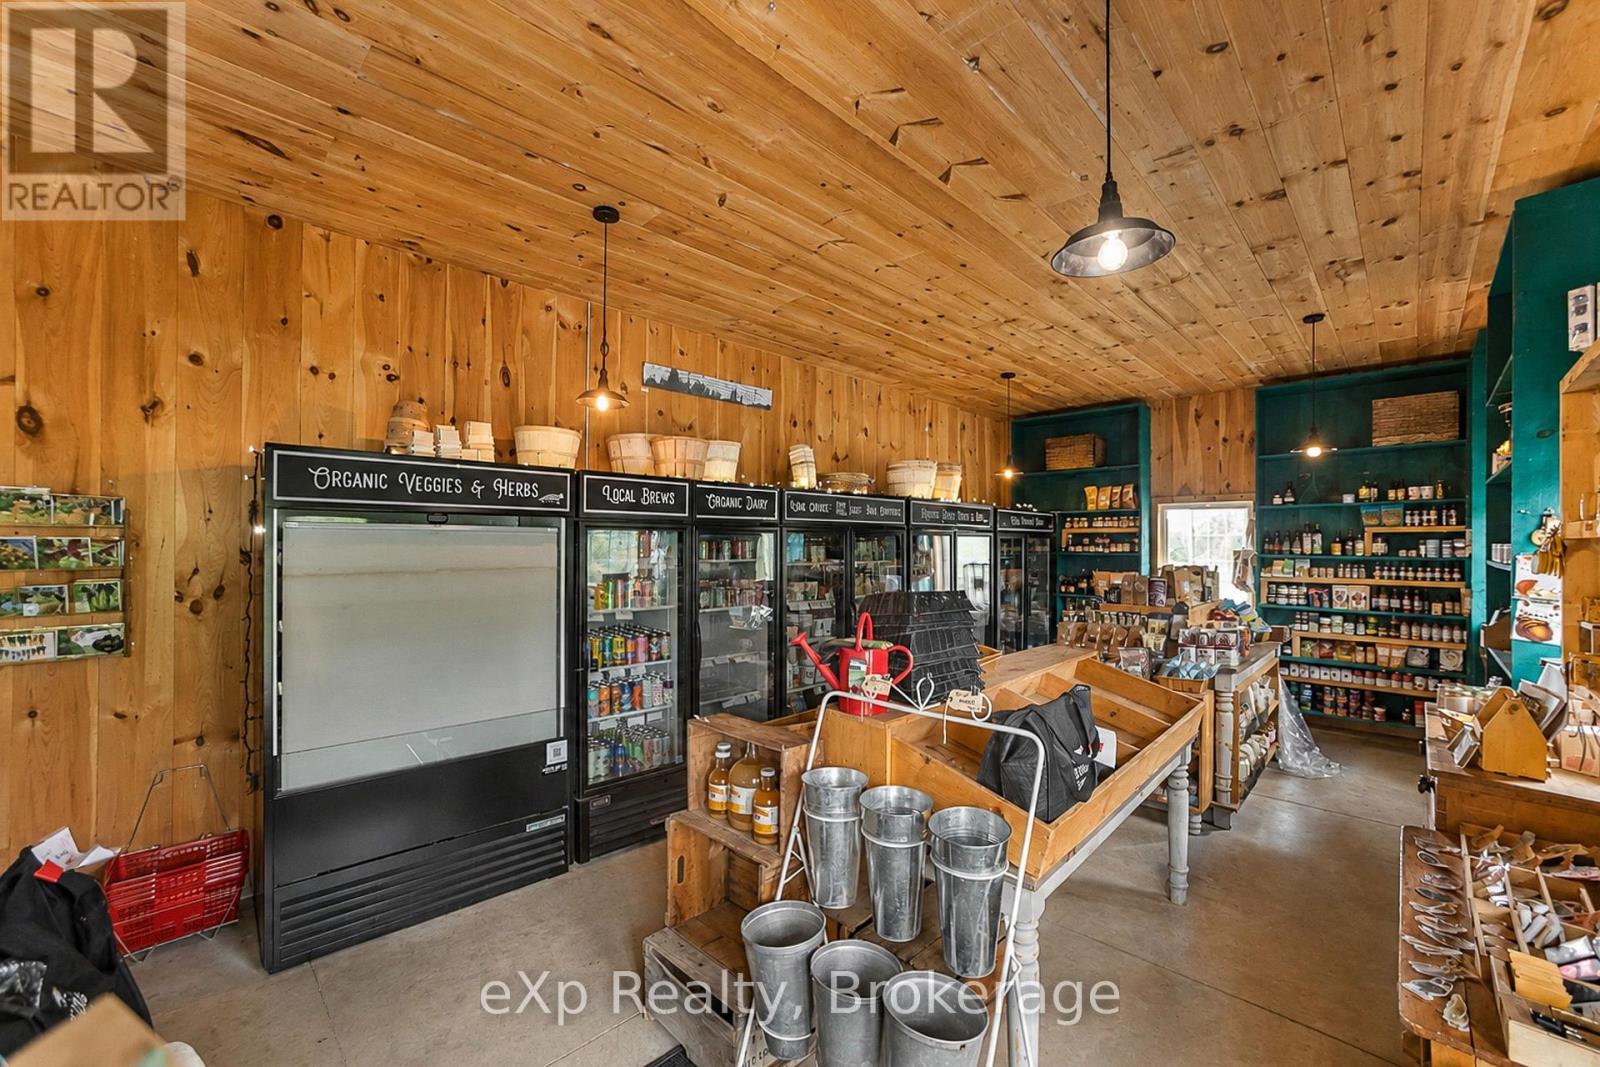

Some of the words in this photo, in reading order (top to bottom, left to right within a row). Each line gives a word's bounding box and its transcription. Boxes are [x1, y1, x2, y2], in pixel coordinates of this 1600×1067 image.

[308, 466, 389, 490] ORGANIC
[398, 471, 463, 495] VEGGIES
[471, 479, 486, 499] &
[493, 477, 539, 500] HERBS
[602, 484, 636, 505] LOCAL
[640, 486, 676, 506] BREWS
[705, 493, 743, 510] ORGANIC
[745, 495, 769, 511] DAIRY
